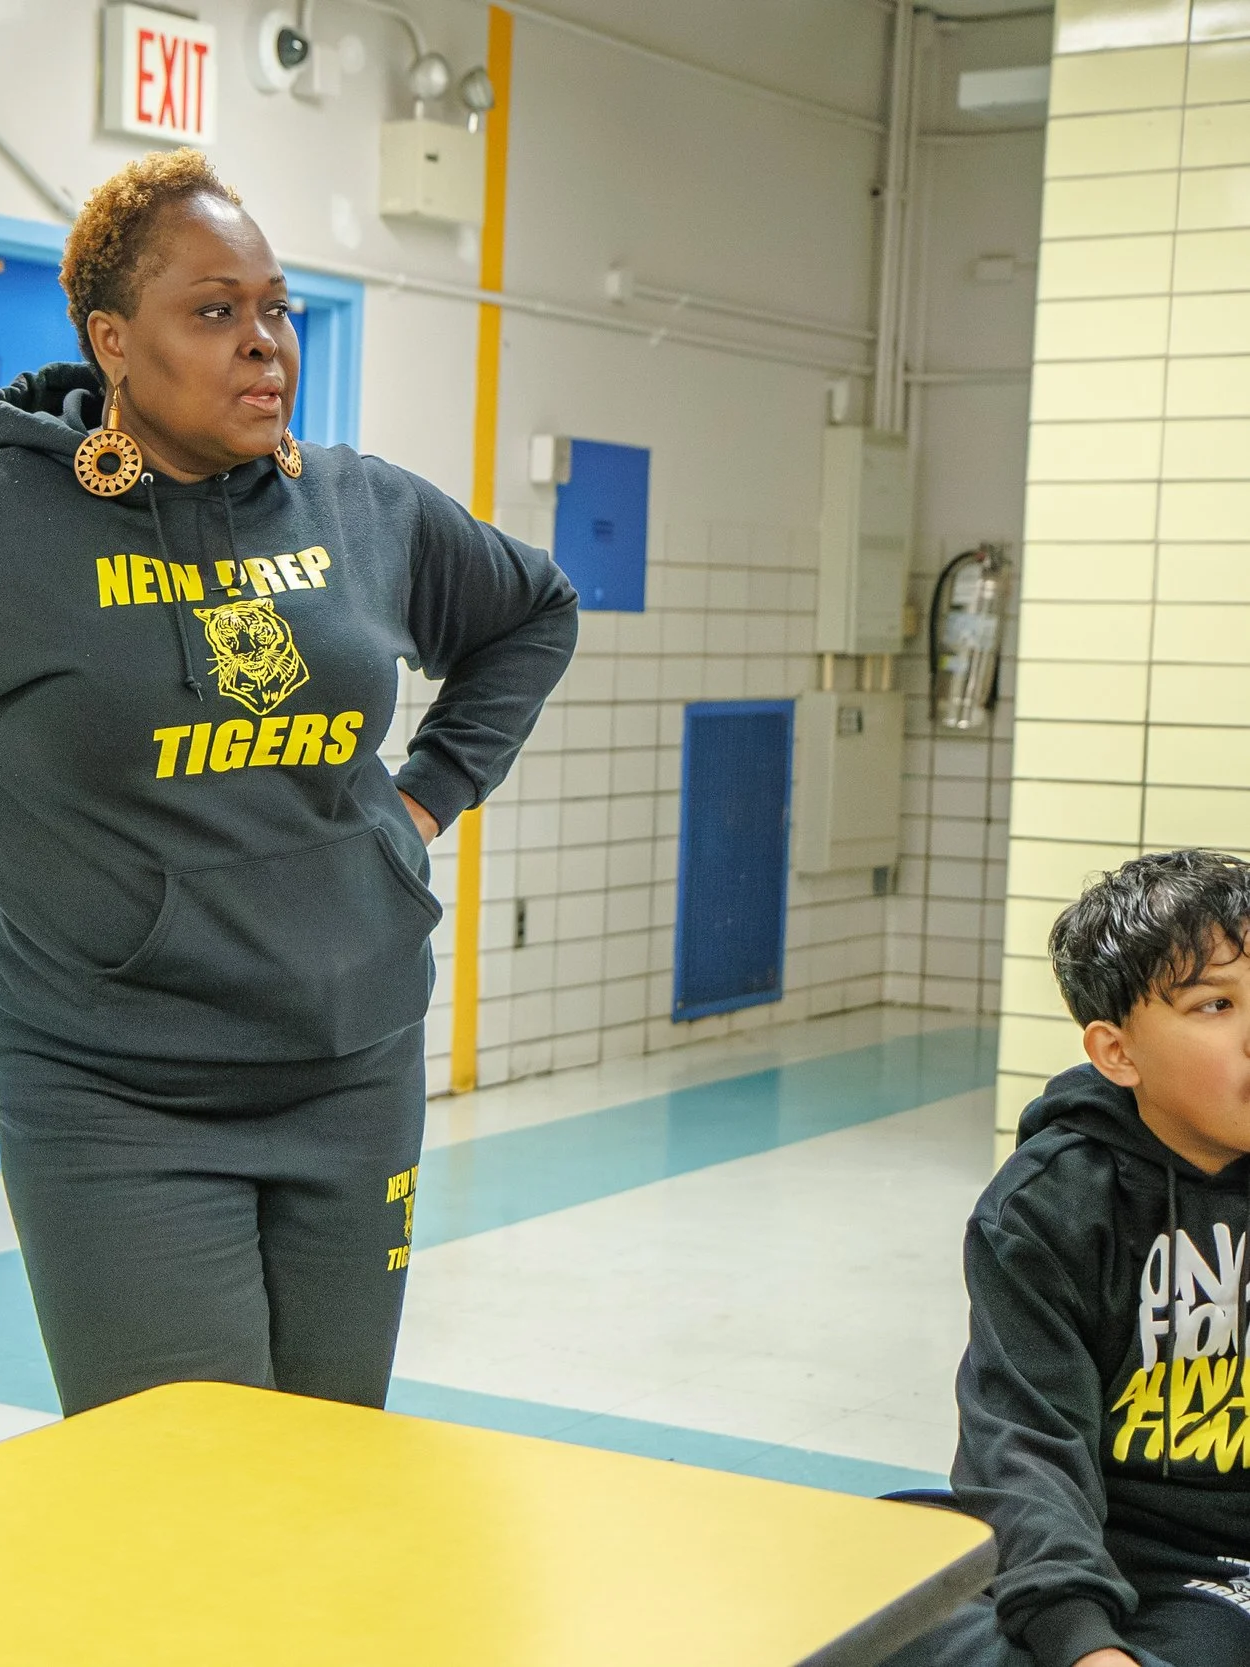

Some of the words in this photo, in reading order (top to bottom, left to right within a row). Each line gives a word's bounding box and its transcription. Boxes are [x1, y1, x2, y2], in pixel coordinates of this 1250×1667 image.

[137, 28, 208, 134] EXIT
[96, 554, 205, 608] NEW
[153, 710, 364, 779] TIGERS
[386, 1169, 410, 1203] NEW
[387, 1245, 411, 1271] TIG
